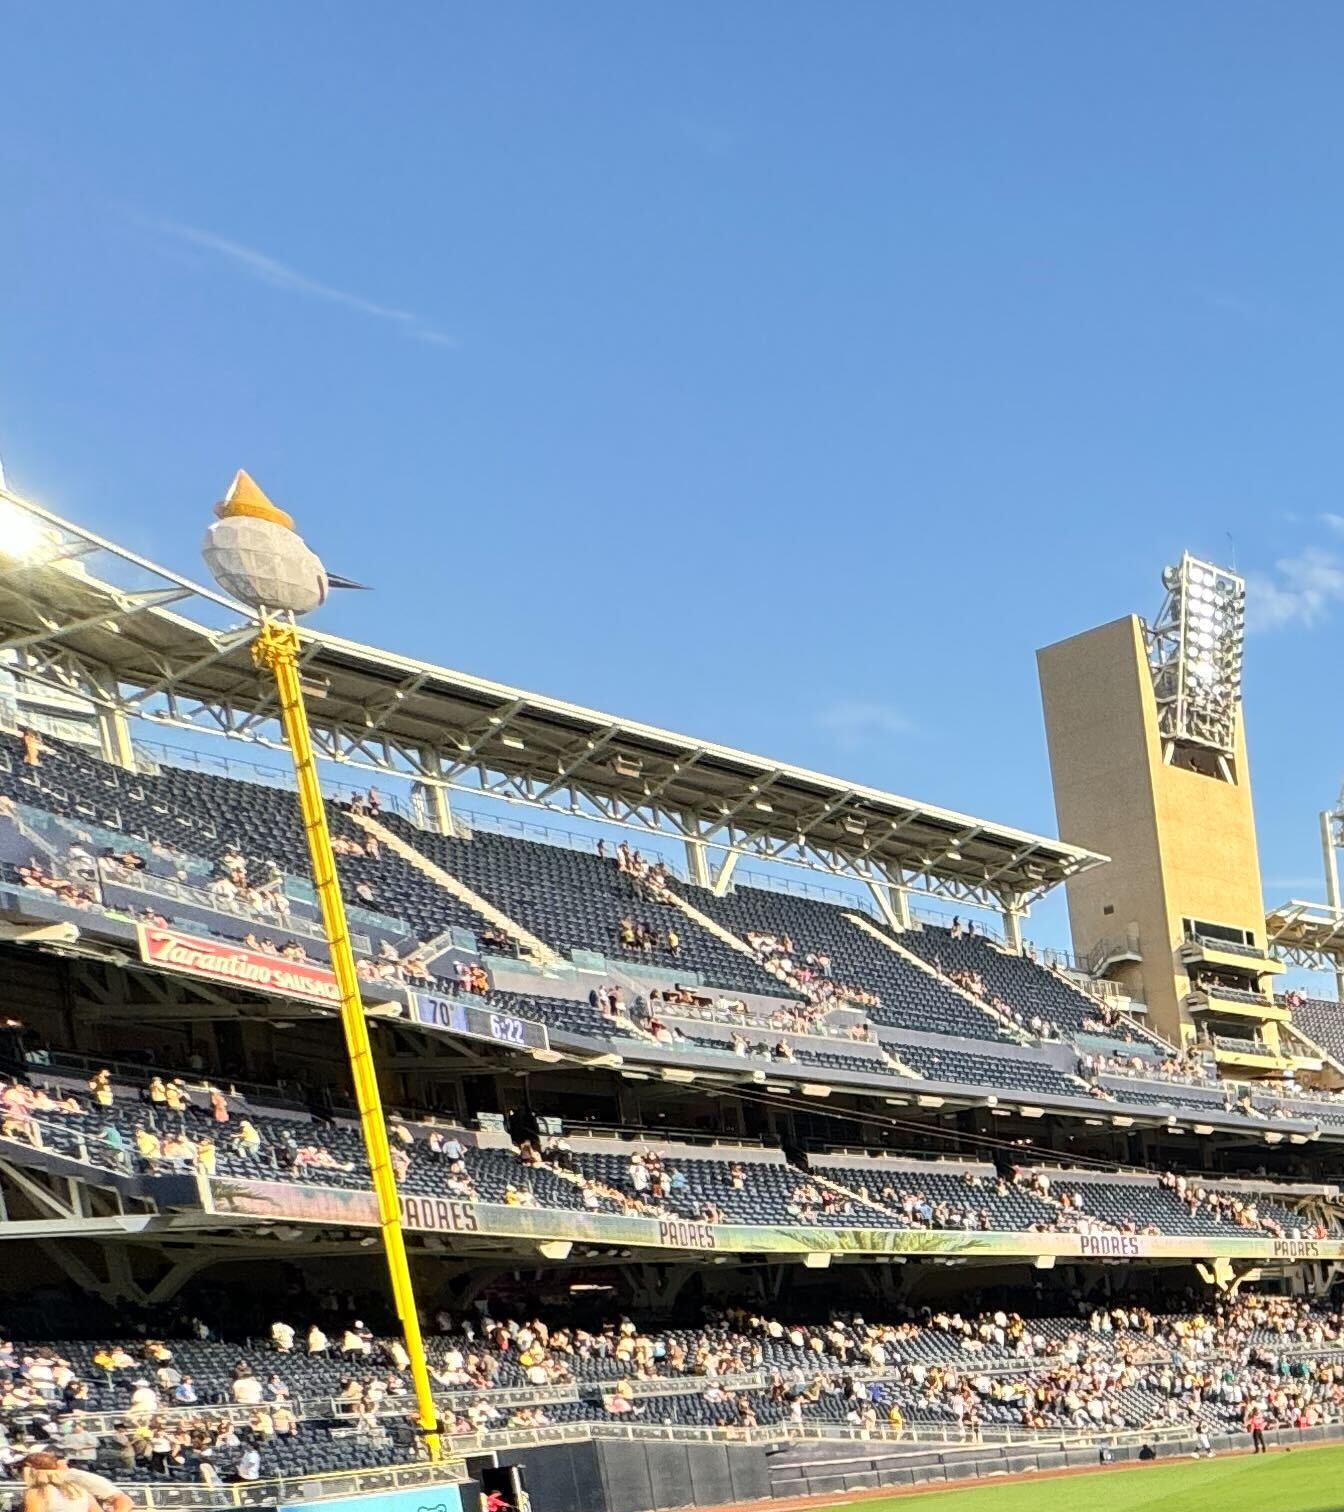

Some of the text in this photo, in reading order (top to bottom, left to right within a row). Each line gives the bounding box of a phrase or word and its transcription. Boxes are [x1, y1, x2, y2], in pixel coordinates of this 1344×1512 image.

[151, 931, 341, 999] Tarantino SAUSAG
[489, 1018, 525, 1044] 6:22
[659, 1220, 715, 1249] PADRES
[1080, 1235, 1139, 1255] PADRES
[1273, 1240, 1319, 1257] PADRES
